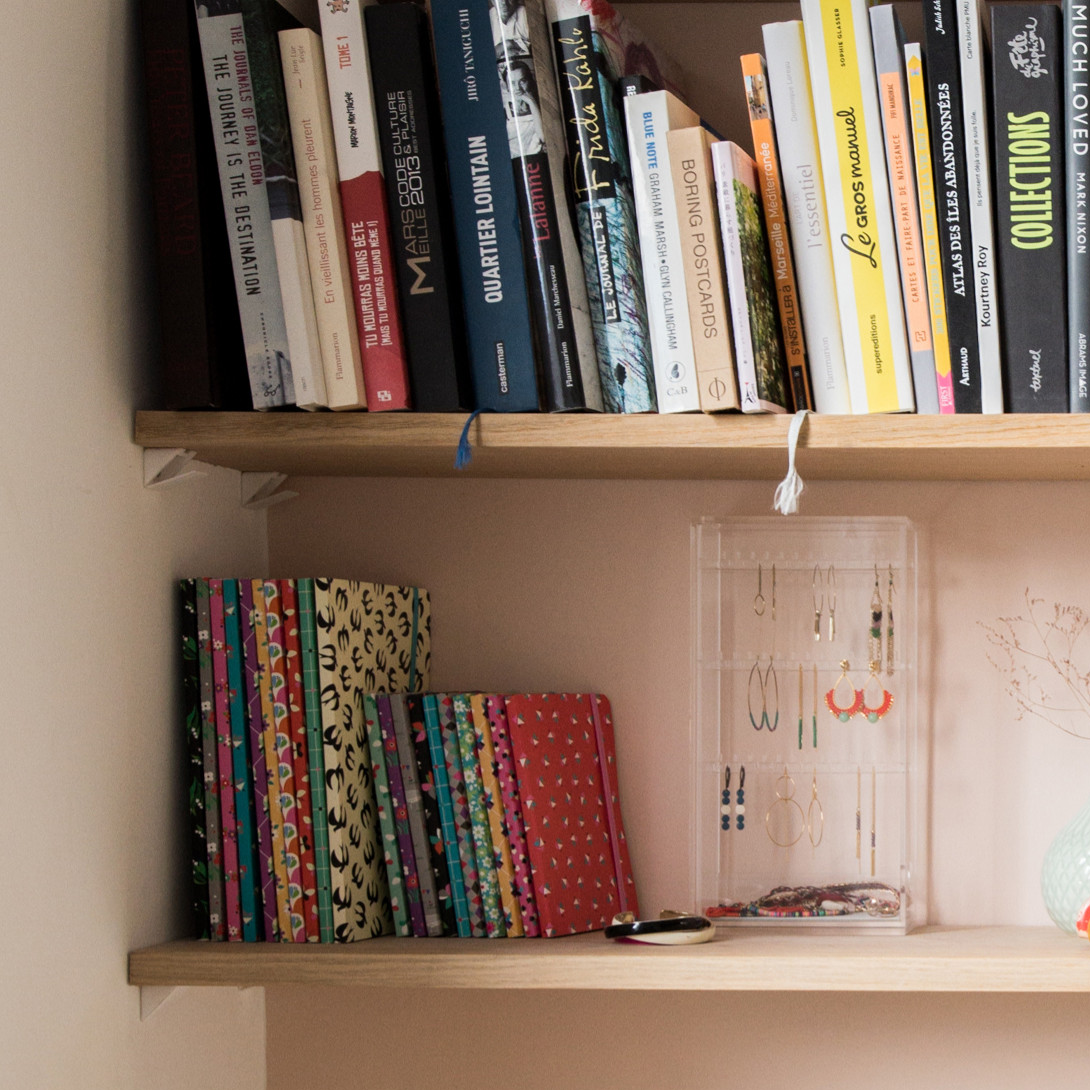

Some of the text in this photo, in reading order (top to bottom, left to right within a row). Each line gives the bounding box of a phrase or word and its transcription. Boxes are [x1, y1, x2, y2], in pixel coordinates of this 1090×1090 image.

[337, 43, 352, 69] TOME
[458, 9, 479, 101] JIRÔ TANIGUCHI
[834, 8, 846, 67] SOPHIE GLASSER
[935, 12, 945, 35] Judith
[230, 25, 263, 186] THE JOURNALS OF DAN ELDON
[344, 91, 359, 148] MARION MONTAIGNE
[387, 92, 402, 155] CULTURE
[397, 91, 412, 154] & PLAISIR
[558, 27, 610, 198] Frida Kahlo
[784, 61, 798, 122] Dominique Loreau
[1071, 5, 1088, 254] MUCH LOVED MARK NIXON
[164, 50, 197, 256] PETER BEARD
[212, 55, 261, 296] THE JOURNEY IS THE DESTINATION
[394, 158, 411, 207] CODE
[406, 156, 425, 205] 2013
[836, 107, 877, 269] Le GROS manuel
[937, 83, 966, 296] ATLAS DES ÎLES ABANDONNÉES
[974, 160, 982, 173] déjà
[1007, 111, 1054, 250] COLLECTIONS
[302, 118, 335, 304] En vieillissant les hommes pleurent
[468, 135, 503, 303] QUARTIER LOINTAIN
[525, 162, 551, 240] Lalanne
[642, 111, 678, 350] BLUE NOTE GRAHAM CALLINGHAM
[759, 142, 788, 280] Marseille Méditerranée
[796, 164, 822, 248] l'essentiel
[892, 134, 920, 303] CARTES ET FAIRE-PART DE NAISSANCE
[914, 98, 943, 315] STICKERS POUR QUE VIE EST BELLE
[351, 221, 378, 348] TU MOURRAS MOINS BÊTE
[369, 228, 389, 323] TU MOURRAS QUAND MÊME
[593, 212, 617, 320] LE JOURNAL DE
[680, 158, 718, 339] BORING POSTCARDS
[977, 245, 991, 327] Kourtney Roy
[548, 265, 565, 329] Daniel Marchesseau
[331, 332, 344, 380] Flammarion
[495, 342, 508, 393] casterman
[560, 341, 573, 387] Flammarion
[821, 336, 835, 390] Flammarion
[869, 314, 883, 374] supereditions
[1029, 348, 1043, 392] textuel
[1078, 333, 1086, 368] ABRAMS
[940, 386, 949, 407] FIRST
